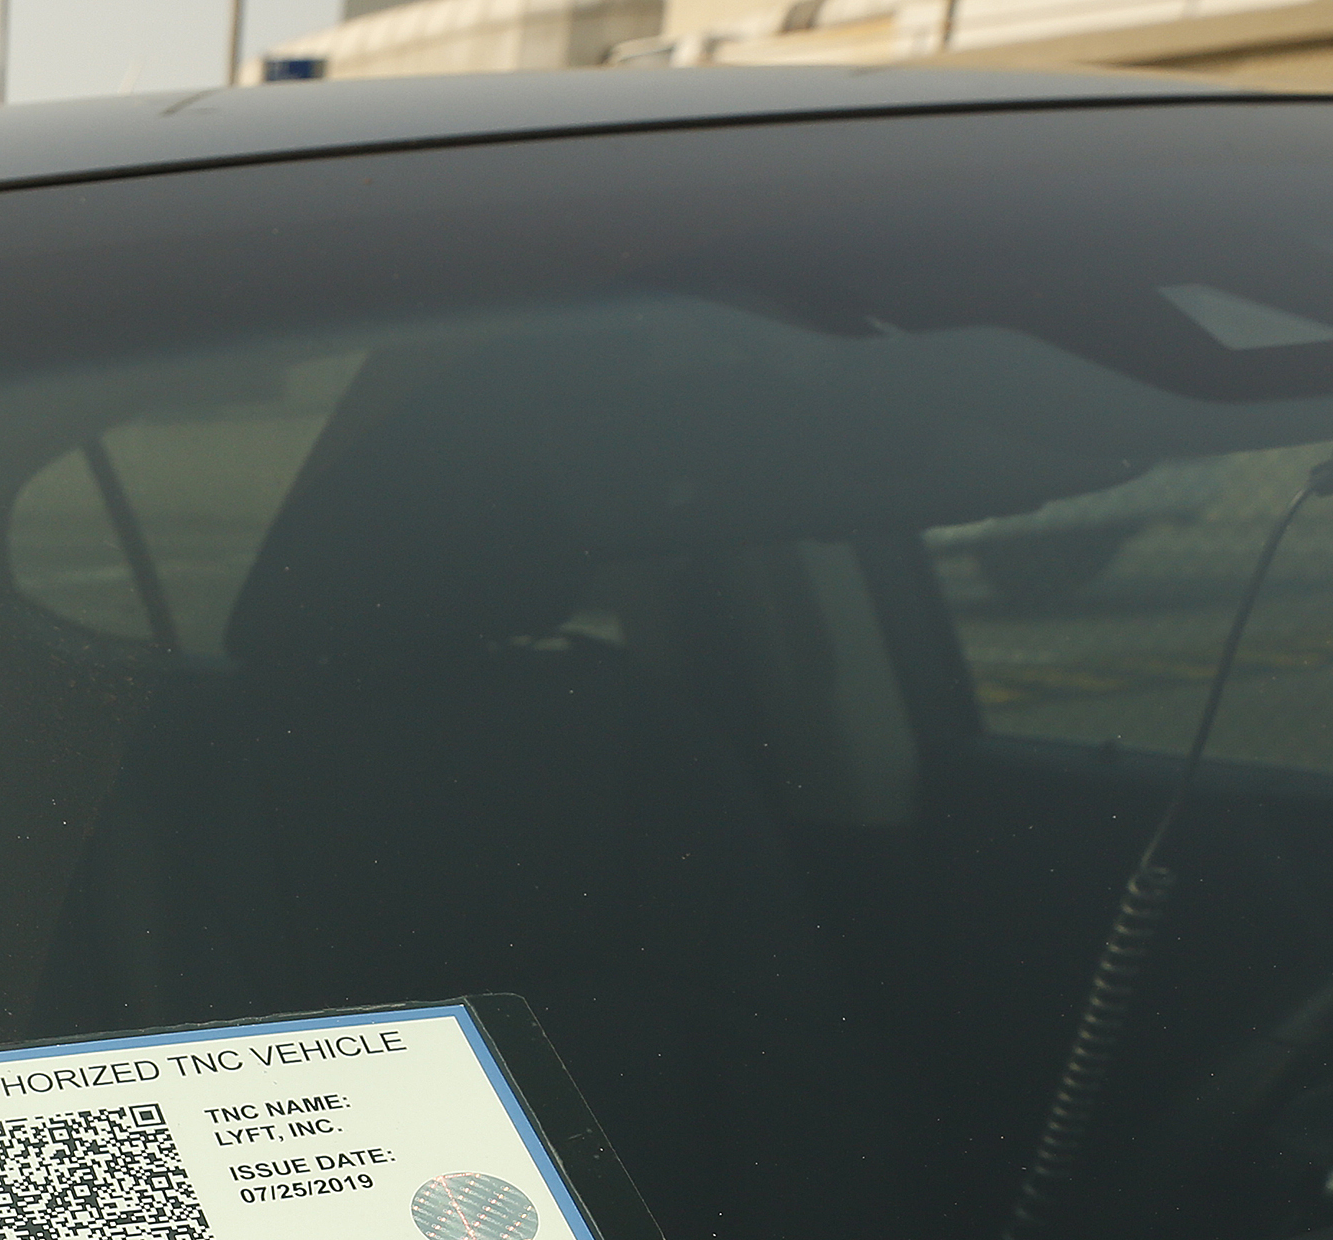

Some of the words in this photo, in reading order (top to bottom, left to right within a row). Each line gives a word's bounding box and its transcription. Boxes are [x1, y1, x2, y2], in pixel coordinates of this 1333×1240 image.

[166, 1050, 243, 1077] TNC
[249, 1030, 408, 1067] VEHICLE
[203, 1104, 260, 1124] TNC
[265, 1094, 351, 1117] NAME:
[214, 1125, 284, 1147] LYFT,
[290, 1118, 343, 1138] INC.
[229, 1157, 311, 1181] ISSUE
[315, 1148, 396, 1171] DATE:
[240, 1173, 374, 1204] 07/25/2019
